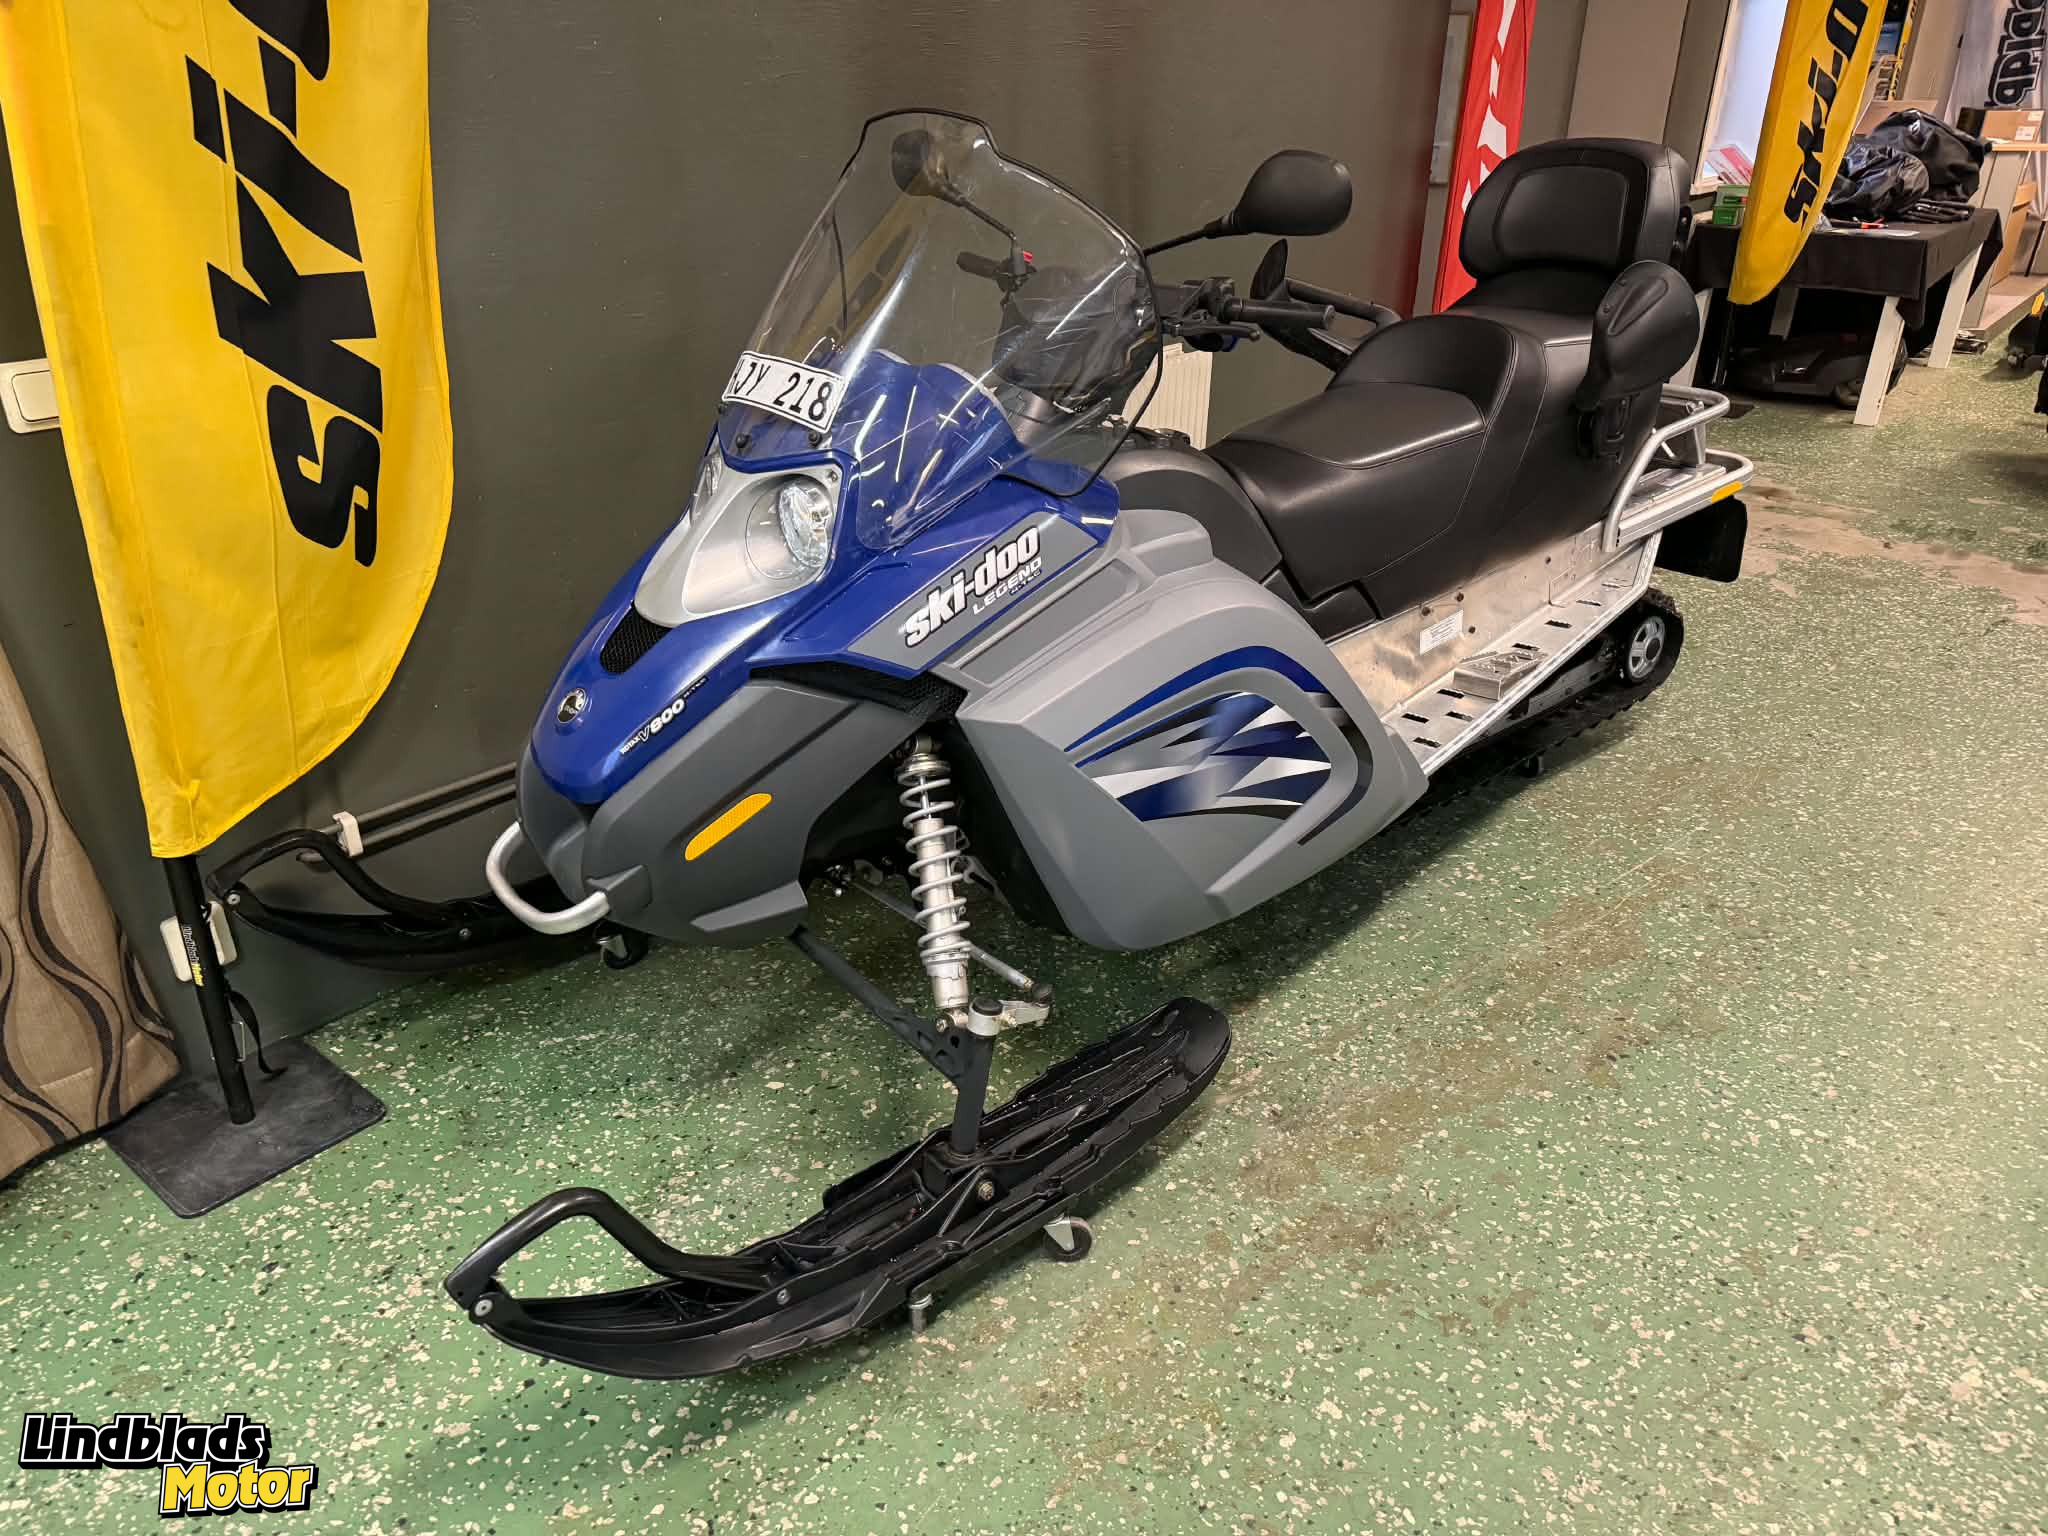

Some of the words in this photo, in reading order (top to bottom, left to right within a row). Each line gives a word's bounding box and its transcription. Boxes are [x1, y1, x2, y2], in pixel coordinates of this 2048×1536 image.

[185, 0, 384, 568] ski-
[729, 361, 771, 396] JY
[772, 372, 833, 422] 218
[905, 532, 1041, 648] ski-doo
[972, 556, 1043, 616] LEGEND
